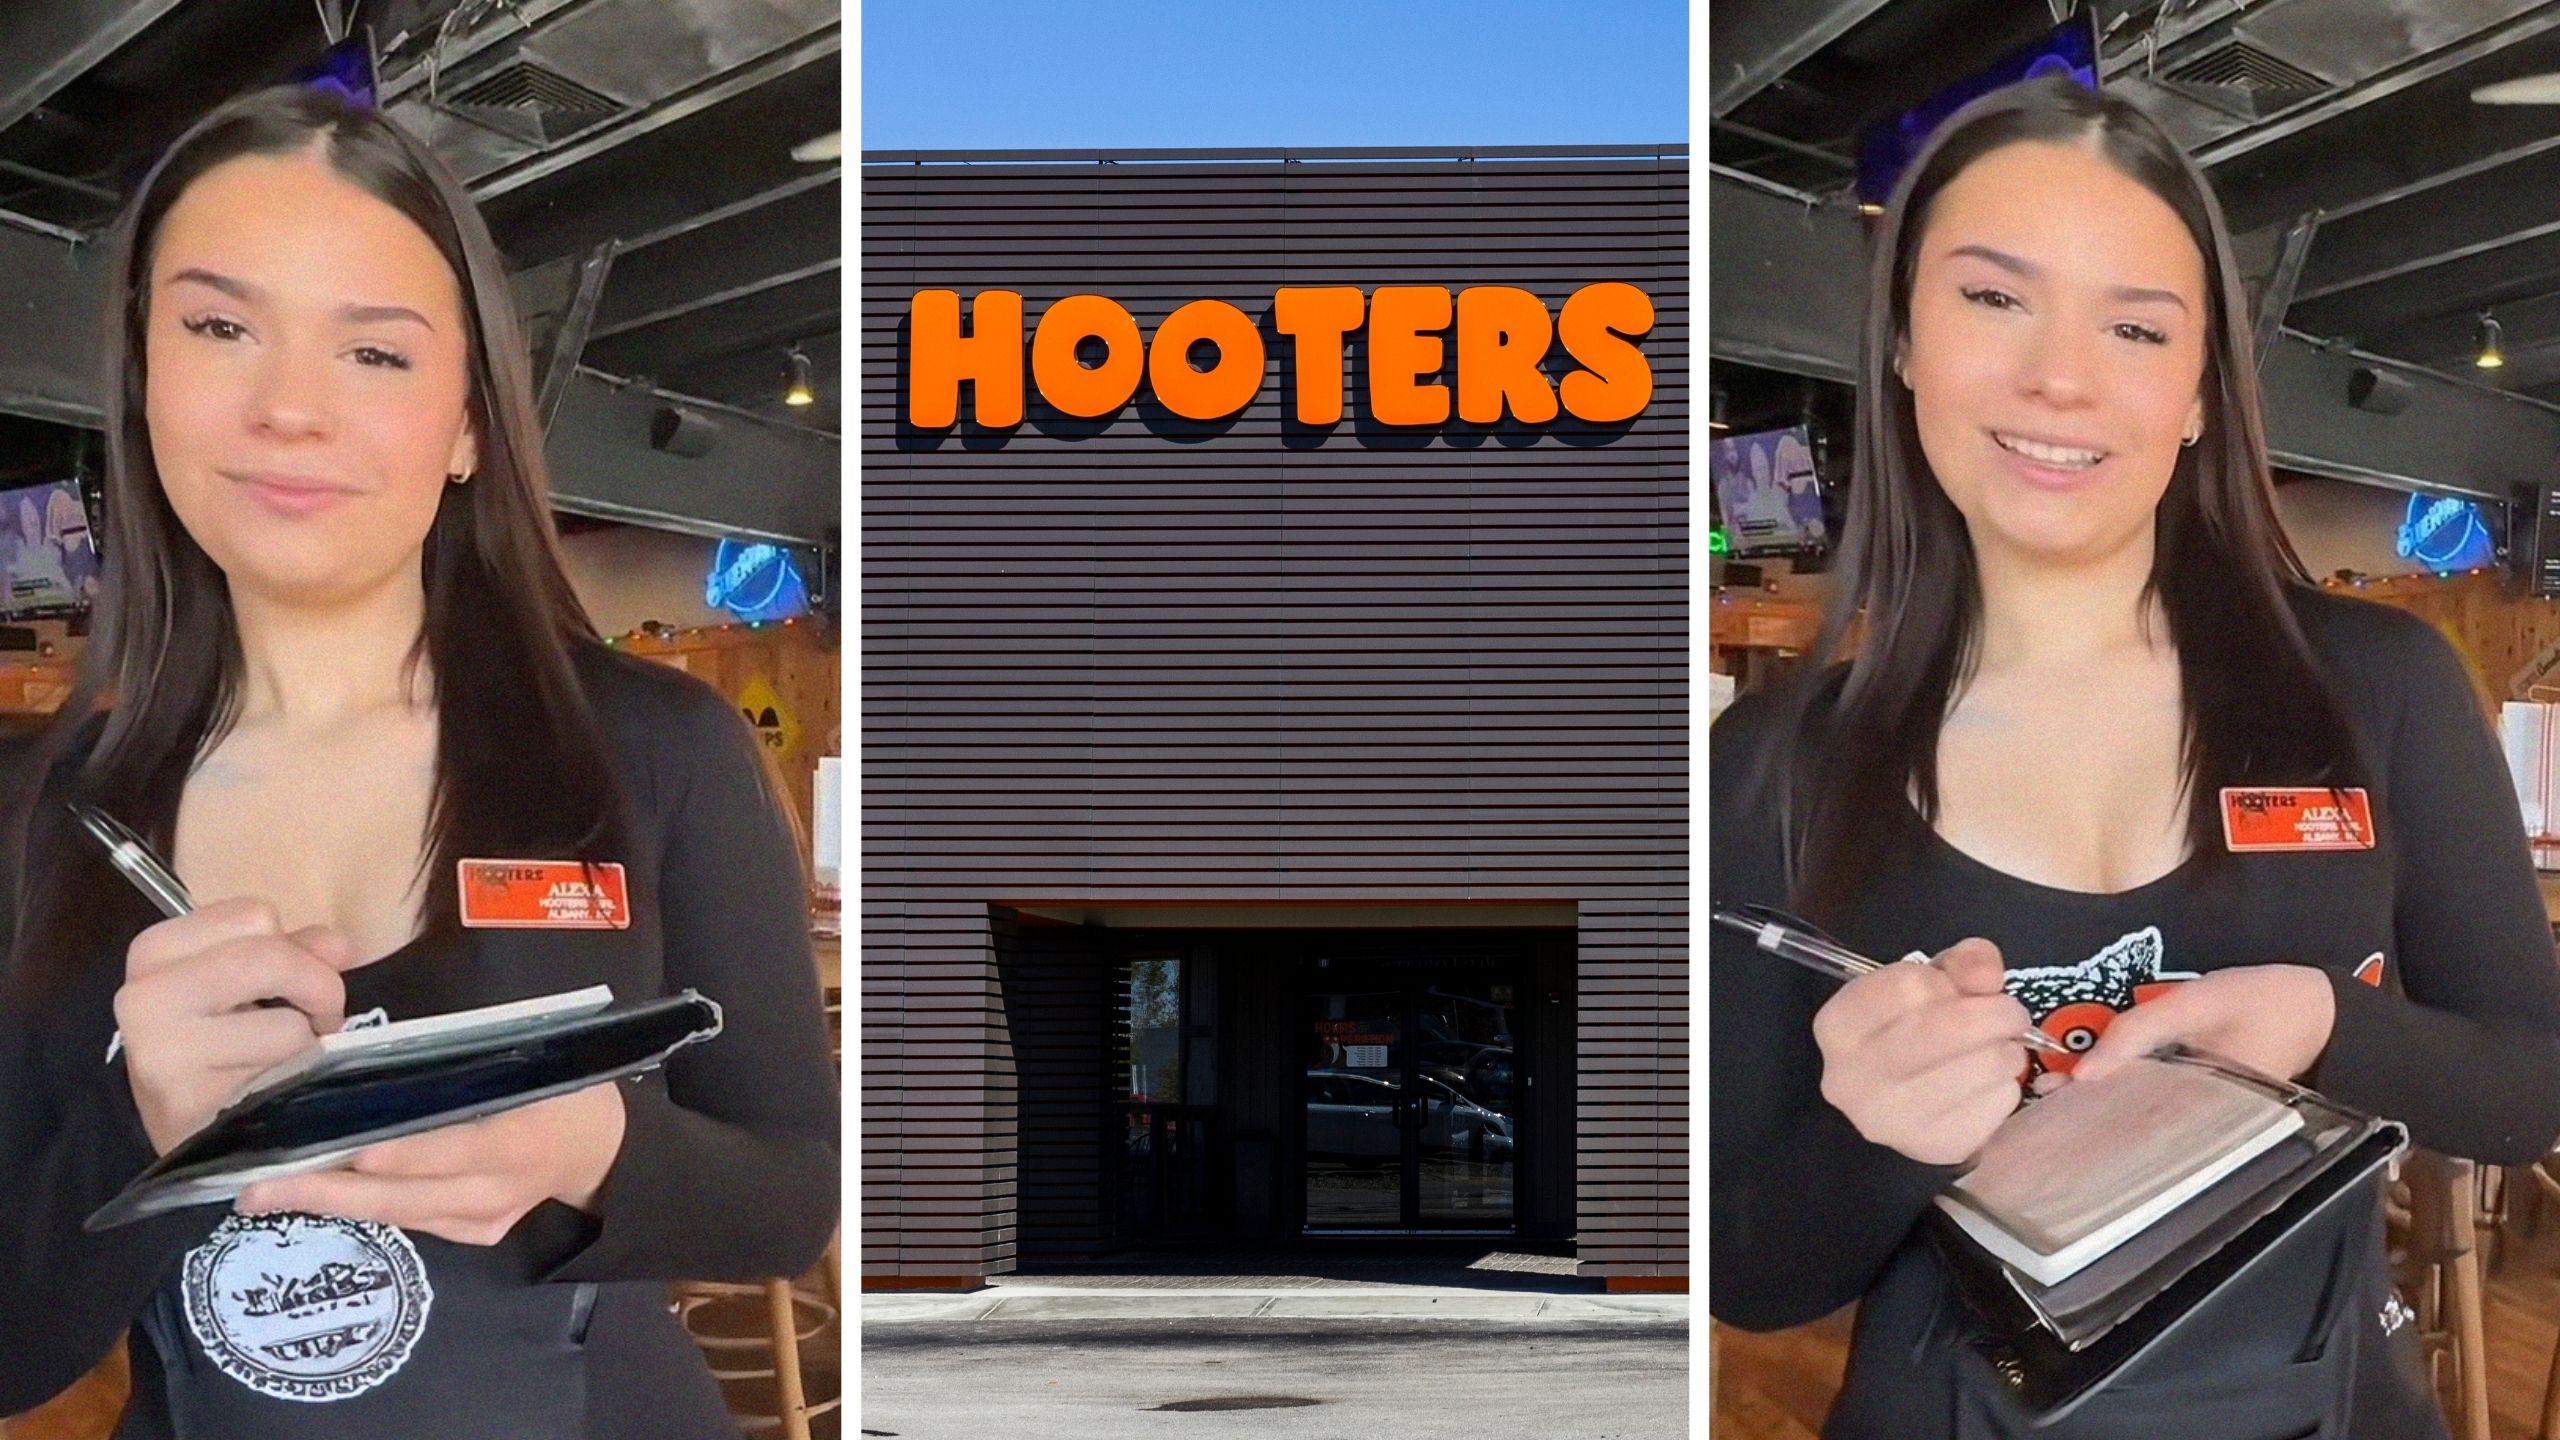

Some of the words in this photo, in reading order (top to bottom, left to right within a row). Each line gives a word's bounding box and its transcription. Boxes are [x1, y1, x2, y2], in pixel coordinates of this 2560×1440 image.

[910, 282, 1656, 429] HOOTERS
[2302, 806, 2352, 822] ALEXA
[548, 881, 606, 897] ALEXA
